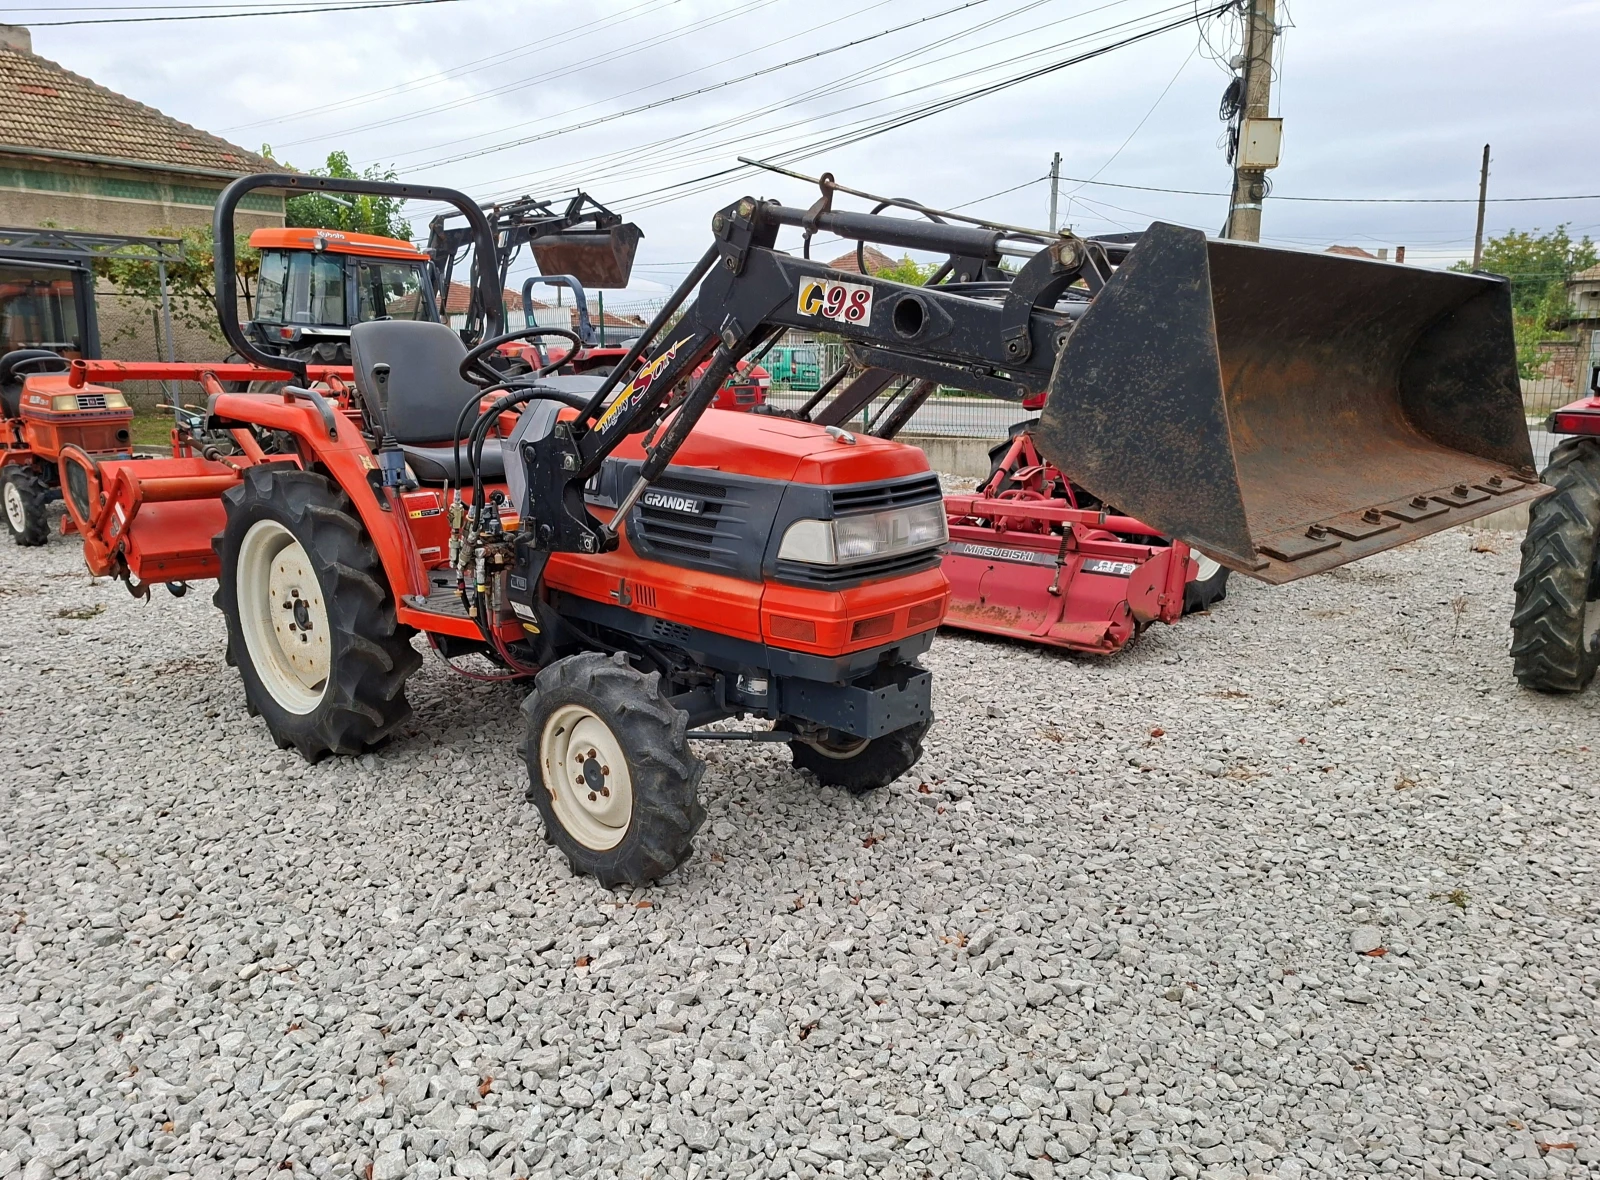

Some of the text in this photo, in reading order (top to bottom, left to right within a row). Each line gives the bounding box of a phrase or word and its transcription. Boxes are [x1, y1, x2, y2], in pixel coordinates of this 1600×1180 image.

[316, 230, 345, 240] Kubota
[799, 281, 871, 322] G98
[644, 492, 700, 514] GRANDEL
[963, 543, 1035, 562] MITSUBISHI
